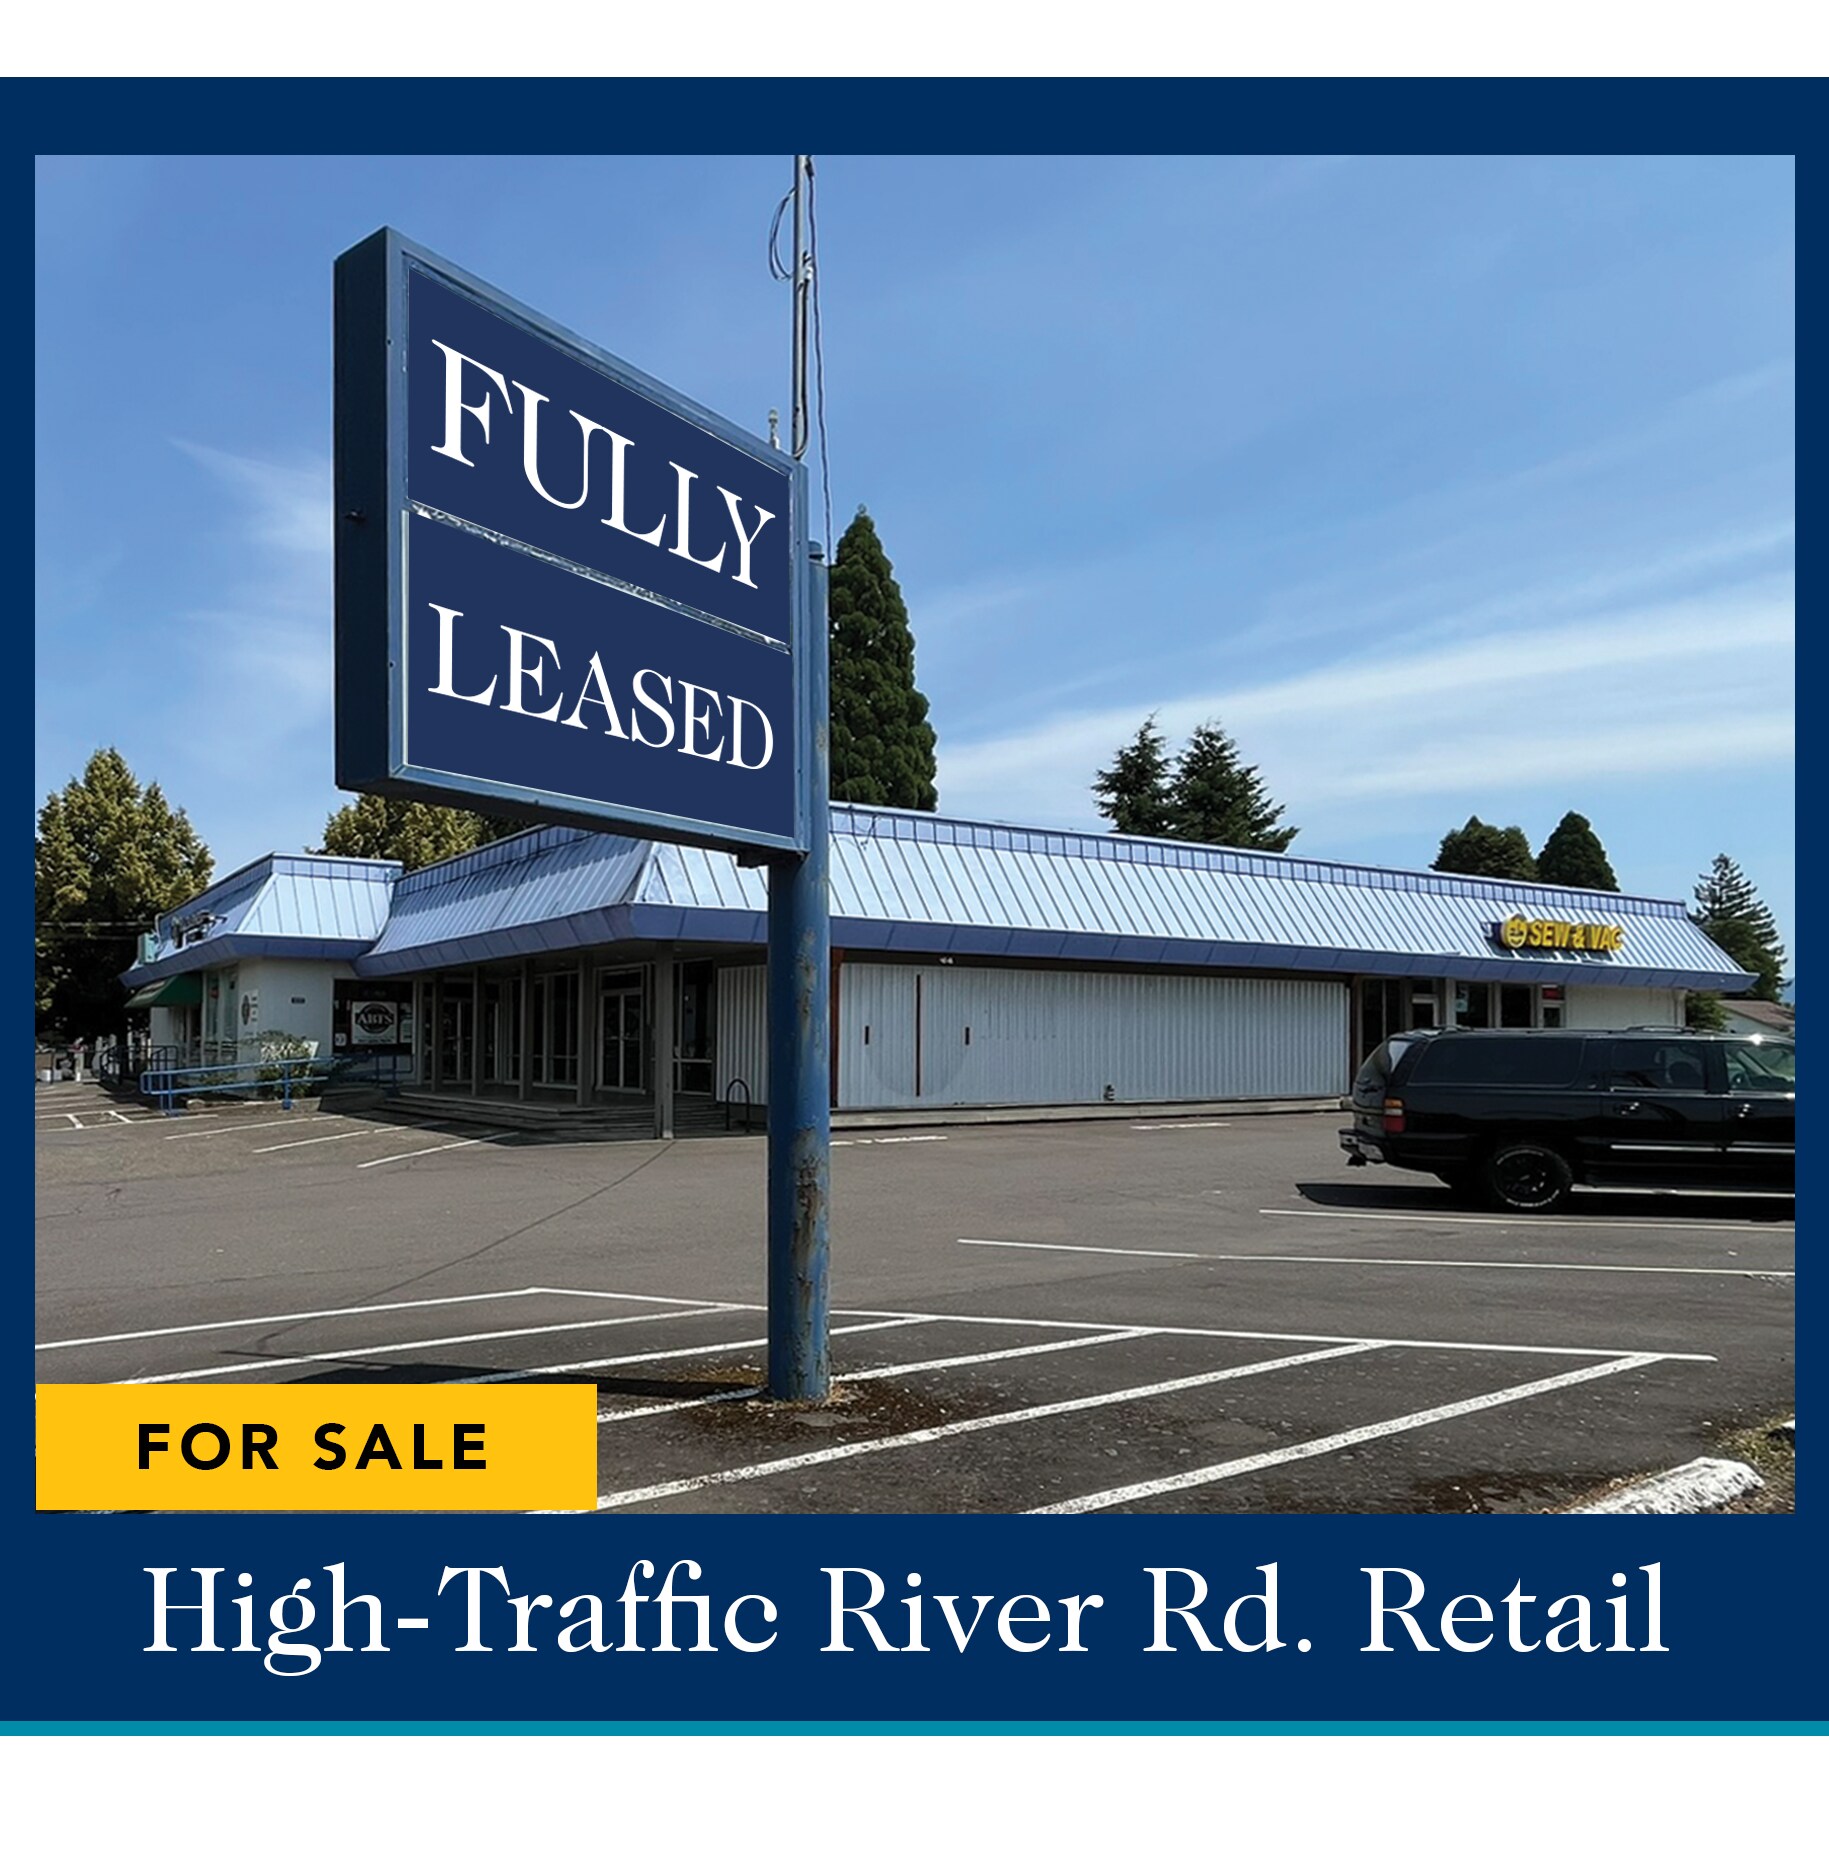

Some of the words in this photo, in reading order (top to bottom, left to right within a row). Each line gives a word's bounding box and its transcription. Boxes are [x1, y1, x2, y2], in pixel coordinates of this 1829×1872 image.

[430, 338, 776, 590] FULLY
[427, 602, 774, 770] LEASED
[1530, 920, 1571, 947] SEW
[1573, 924, 1586, 948] &
[1591, 925, 1622, 950] VAC
